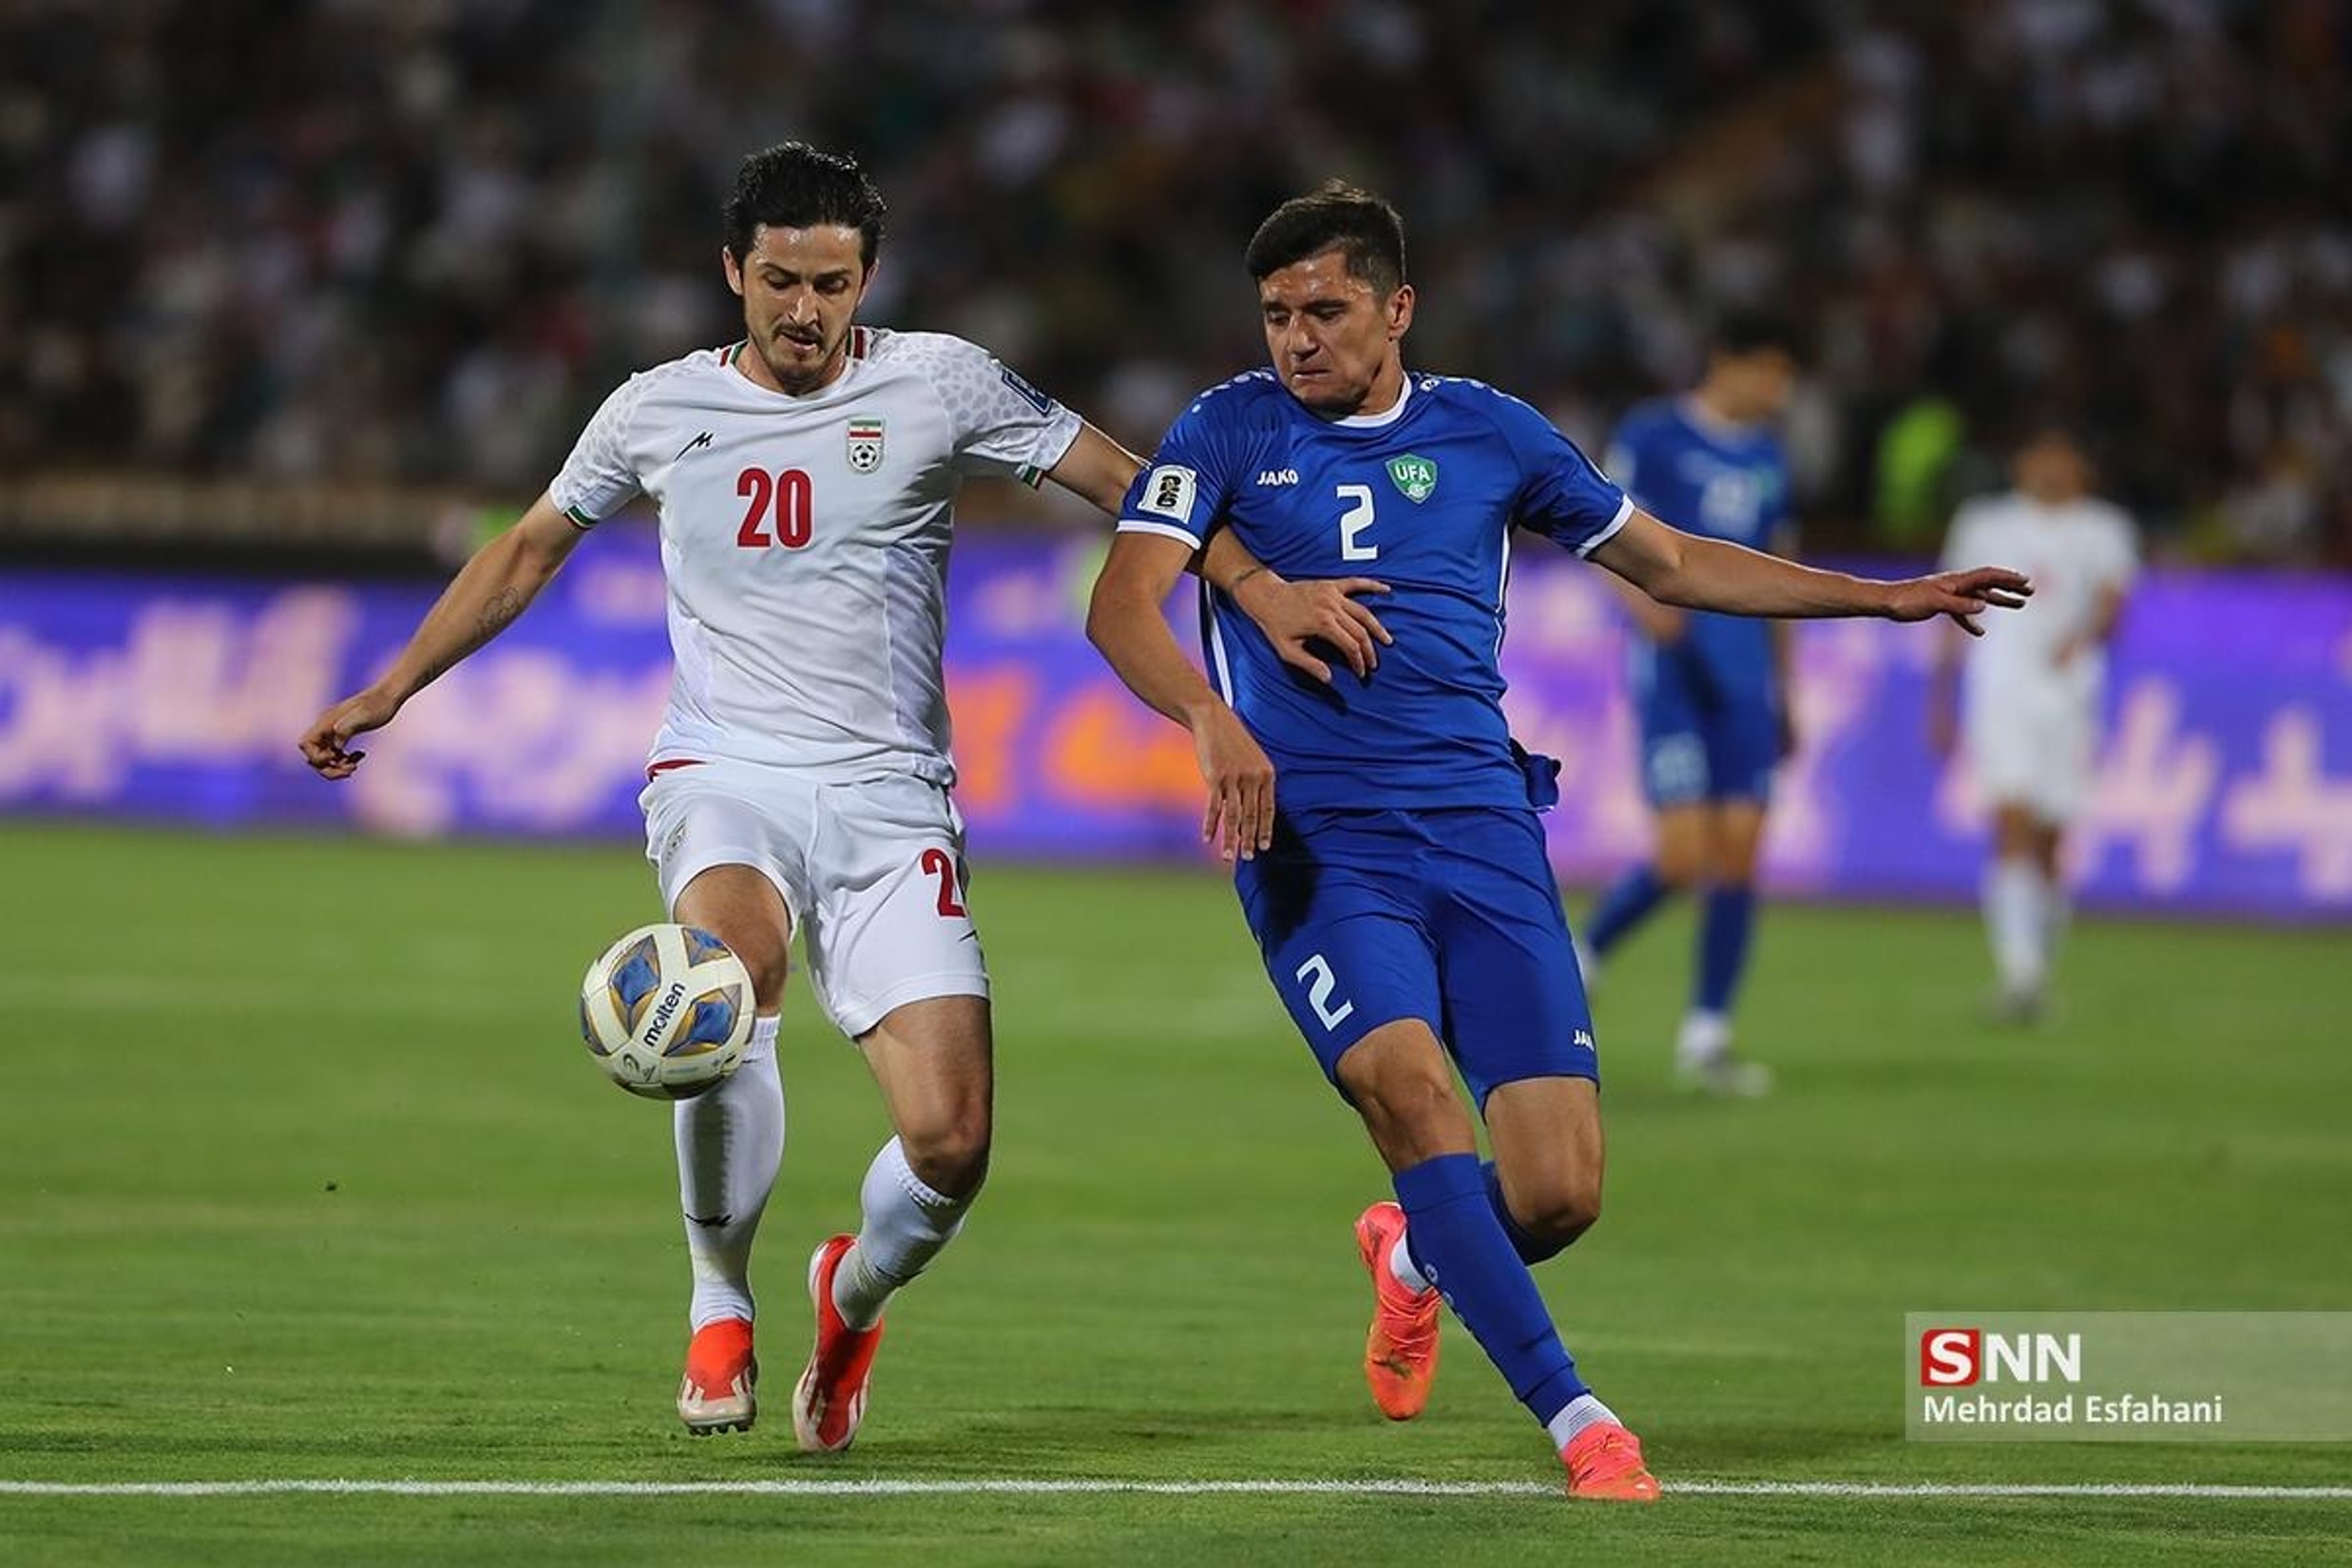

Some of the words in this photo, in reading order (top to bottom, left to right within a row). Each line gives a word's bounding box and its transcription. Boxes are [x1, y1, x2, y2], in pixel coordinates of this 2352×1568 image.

[736, 467, 813, 549] 20
[1256, 468, 1299, 487] JAKO
[1394, 464, 1431, 483] UFA
[1336, 485, 1378, 561] 2
[642, 981, 687, 1047] molten
[1295, 953, 1355, 1033] 2
